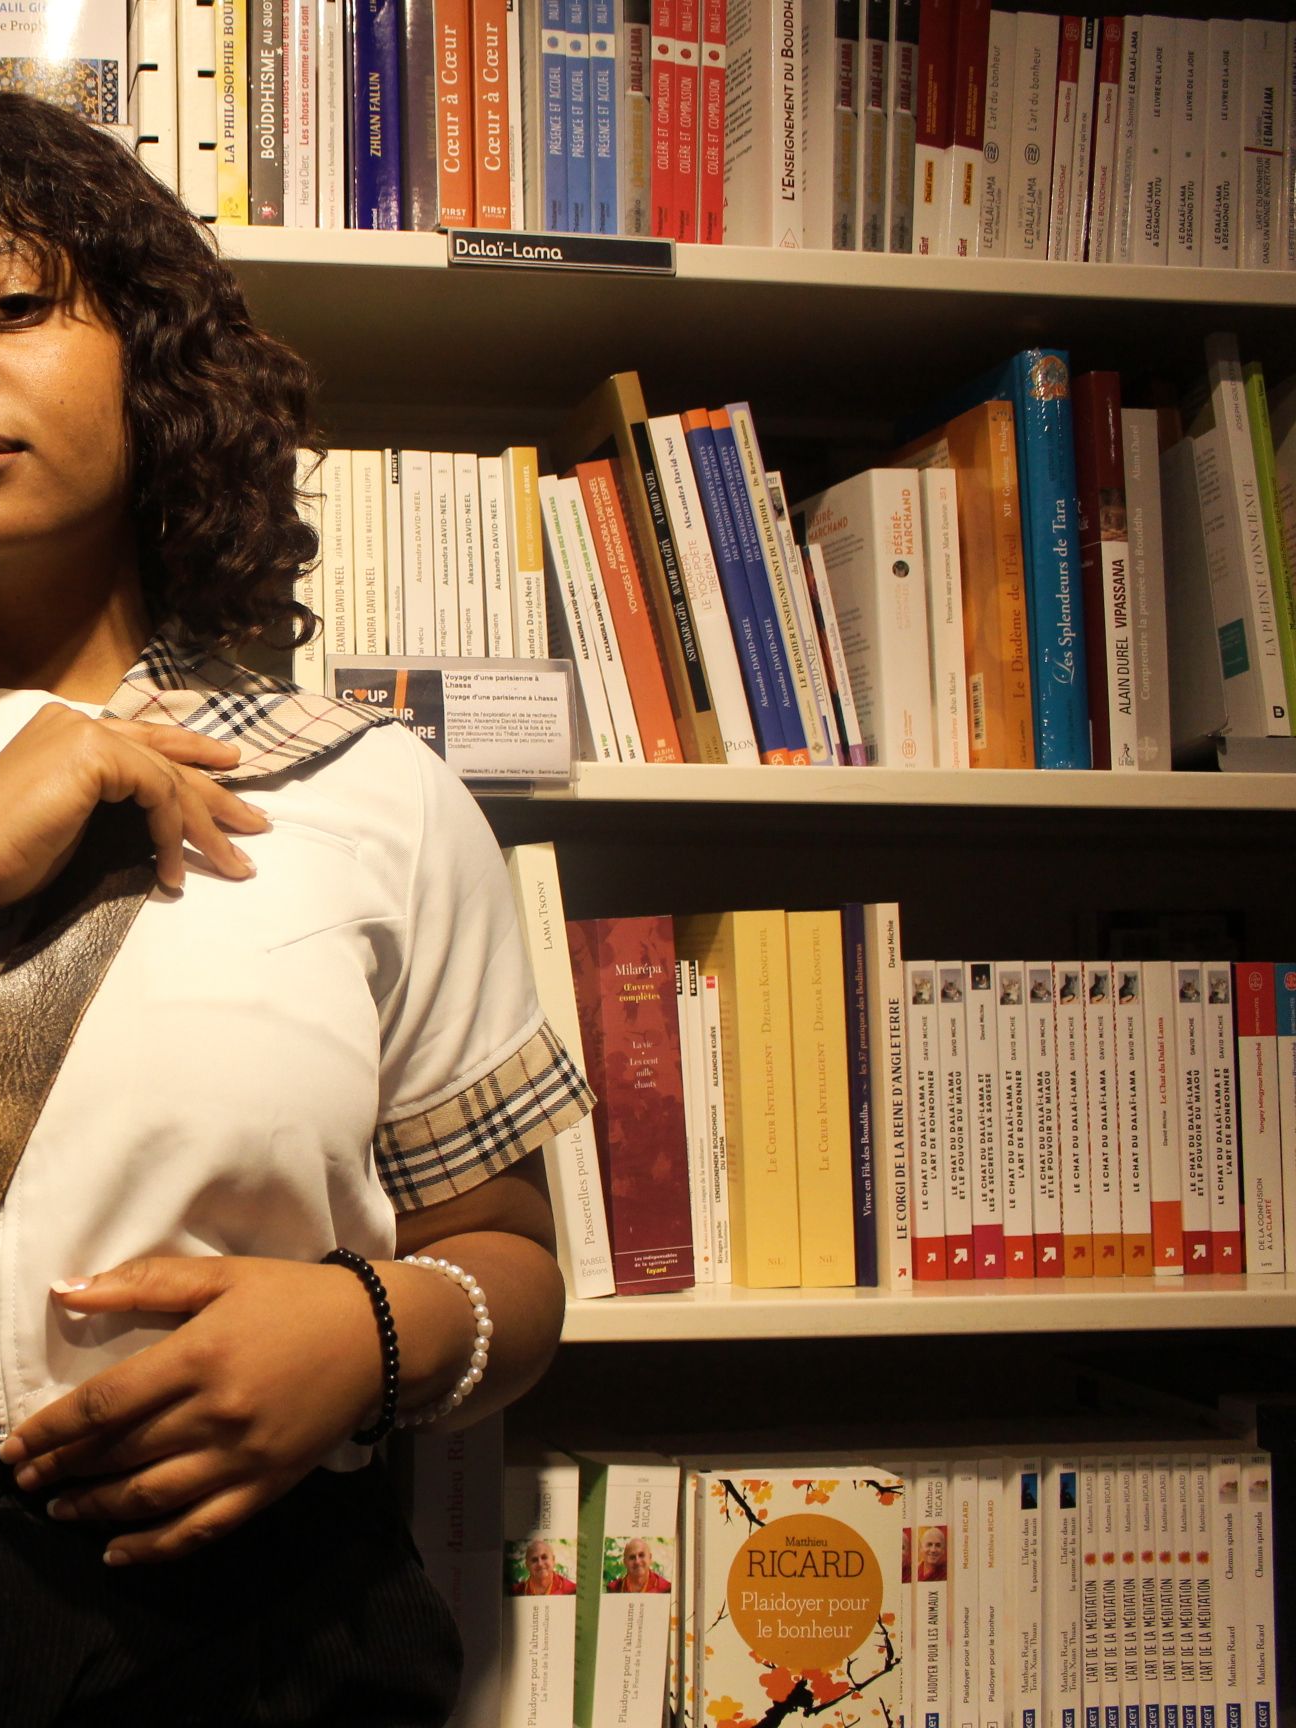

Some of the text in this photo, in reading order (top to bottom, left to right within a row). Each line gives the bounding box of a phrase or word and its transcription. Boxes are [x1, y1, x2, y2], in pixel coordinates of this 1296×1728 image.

[781, 0, 794, 59] BOUDDH
[630, 28, 643, 91] DALAÏ-LAMA
[784, 62, 794, 81] DU
[300, 6, 310, 145] Les choses comme elles sont
[224, 40, 234, 163] LA PHILOSOPHIE
[260, 30, 275, 159] BOUDDHISME AU
[441, 25, 460, 173] Cœur à Cœur
[482, 22, 502, 170] Cœur à Cœur
[369, 72, 381, 156] ZHUAN FALUN
[656, 73, 669, 169] COLÈRE ET COMPASSION
[442, 208, 466, 216] FIRST
[1145, 182, 1154, 240] LE DALAÏ-LAMA
[1153, 199, 1161, 240] DESMOND
[455, 238, 563, 261] Dalaï-Lama
[464, 493, 473, 543] DAVID-NEEL
[1051, 499, 1077, 684] Les Splendeurs de Tara
[1112, 559, 1132, 714] ALAIN DUREL VIPASSANA
[445, 694, 471, 702] Voyage
[724, 738, 754, 752] PLON
[886, 920, 895, 945] Michie
[616, 964, 662, 978] Milarépa
[619, 993, 660, 1003] complètes
[623, 983, 654, 991] Œuvres
[1069, 1070, 1079, 1131] DALAÏ-LAMA
[888, 998, 908, 1239] LE CORGI DE LA REINE D'ANGLETERRE
[1072, 1136, 1079, 1148] DU
[571, 1133, 595, 1245] Passerelles pour le
[1074, 1183, 1081, 1193] LE
[646, 1266, 667, 1275] fayard
[785, 1536, 828, 1547] Matthieu
[747, 1550, 864, 1578] RICARD
[741, 1592, 870, 1617] Plaidoyer pour
[757, 1620, 853, 1638] le bonheur
[1085, 1633, 1097, 1644] LA
[1086, 1647, 1098, 1658] DE
[1086, 1660, 1098, 1682] L'ART
